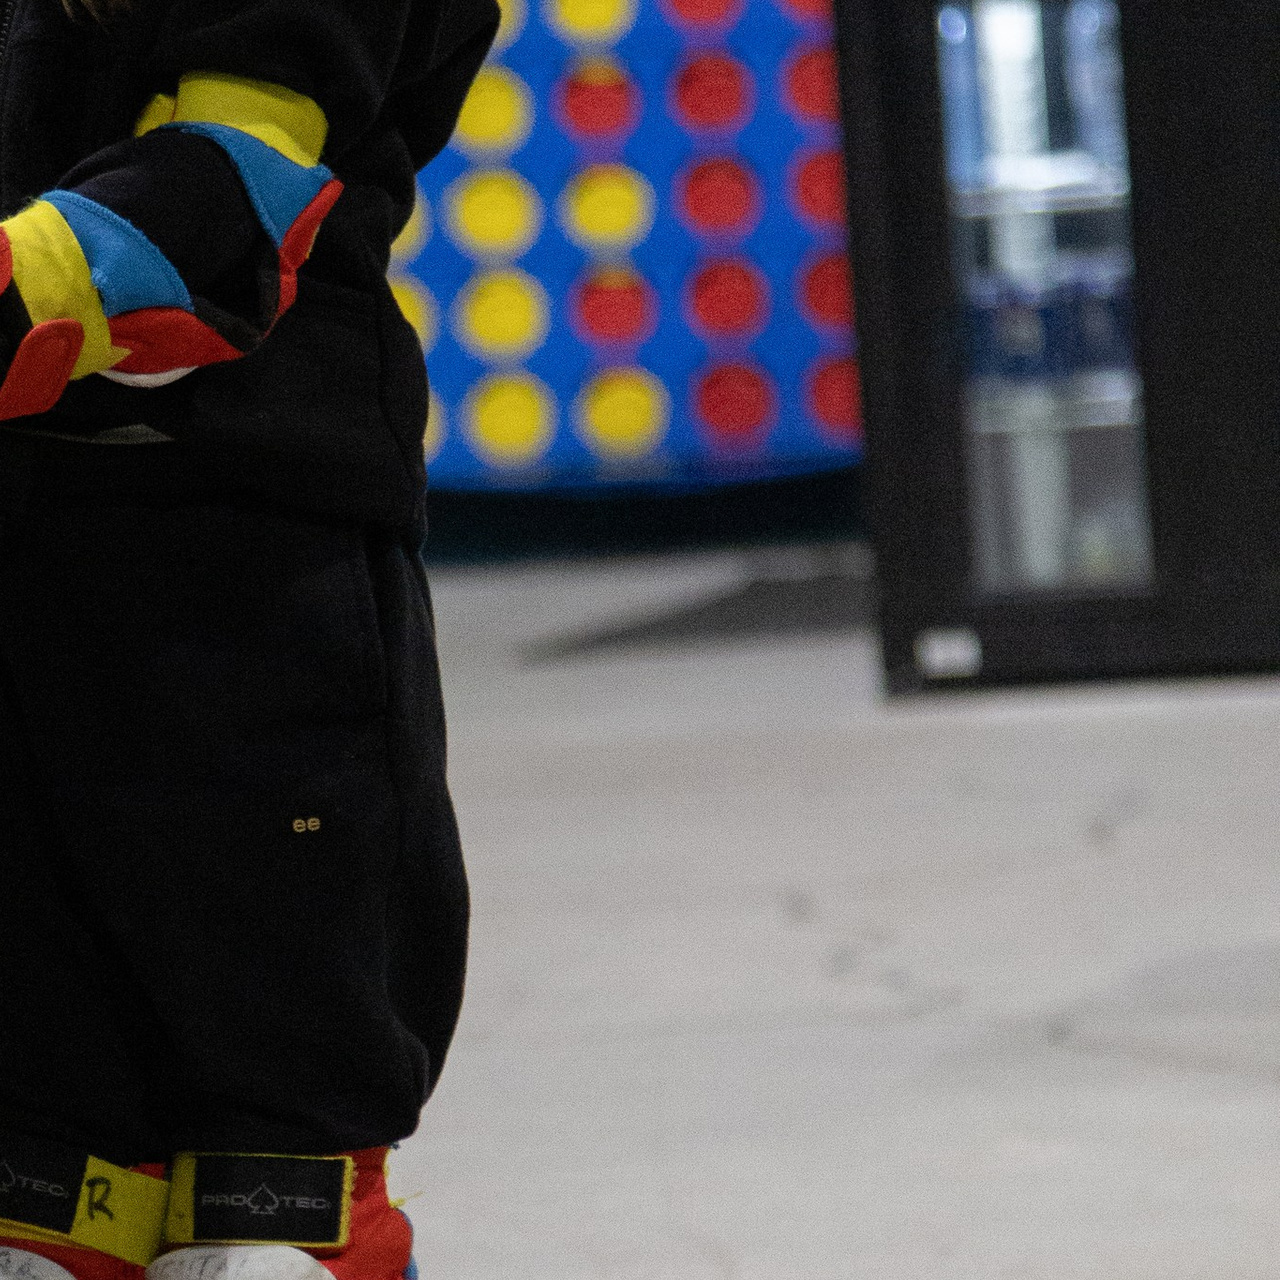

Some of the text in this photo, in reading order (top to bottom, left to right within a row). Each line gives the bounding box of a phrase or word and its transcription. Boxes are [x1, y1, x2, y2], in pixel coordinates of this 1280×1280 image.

[85, 1176, 114, 1221] R
[201, 1193, 328, 1210] PRO TEC
